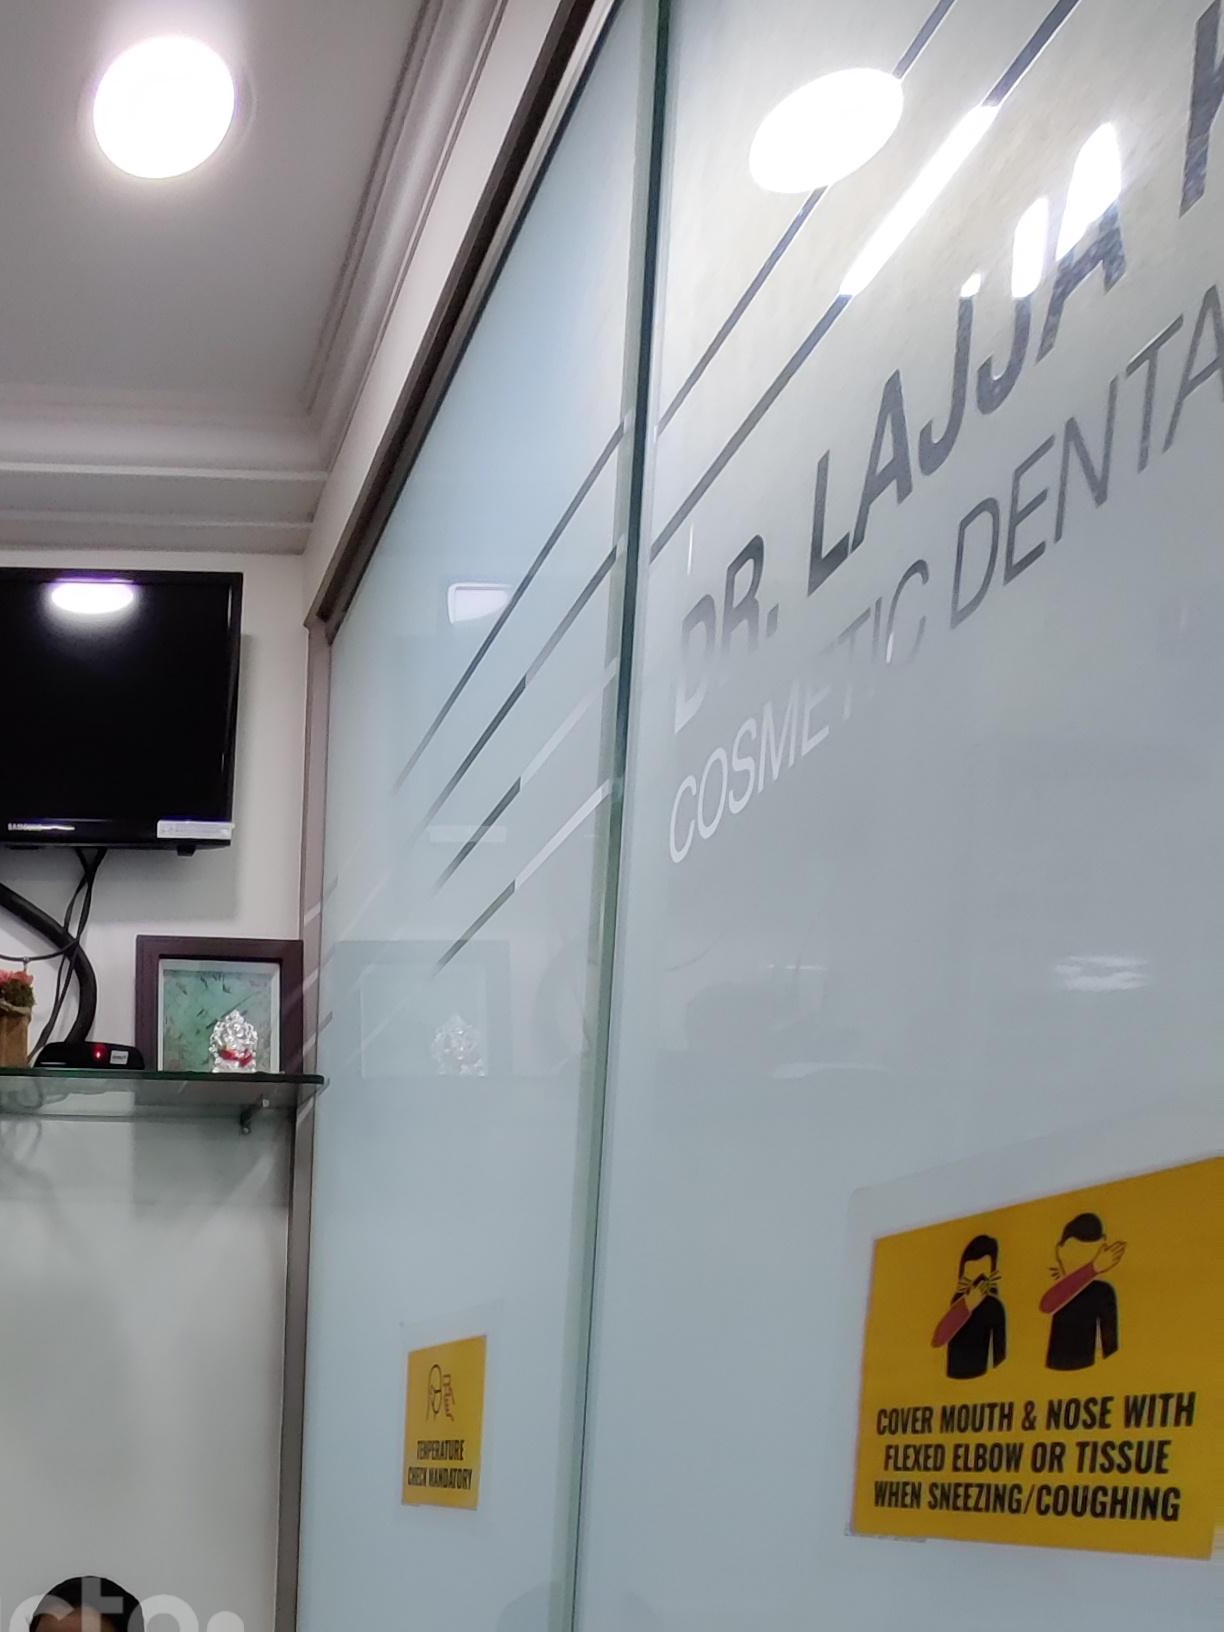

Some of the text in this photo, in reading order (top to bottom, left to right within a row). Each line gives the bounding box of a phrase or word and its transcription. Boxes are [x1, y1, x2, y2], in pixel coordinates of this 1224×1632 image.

[807, 121, 1127, 598] LAJJA
[669, 559, 929, 863] COSMETIC
[877, 1392, 1196, 1435] COVER MOUTH & NOSE WITH
[417, 1439, 464, 1460] TEMPERATURE
[884, 1439, 1172, 1475] FLEXED ELBOW OR TISSUE
[408, 1467, 472, 1490] CHECK MANDATORY
[874, 1480, 1181, 1522] WHEN SNEEZING/COUGHING
